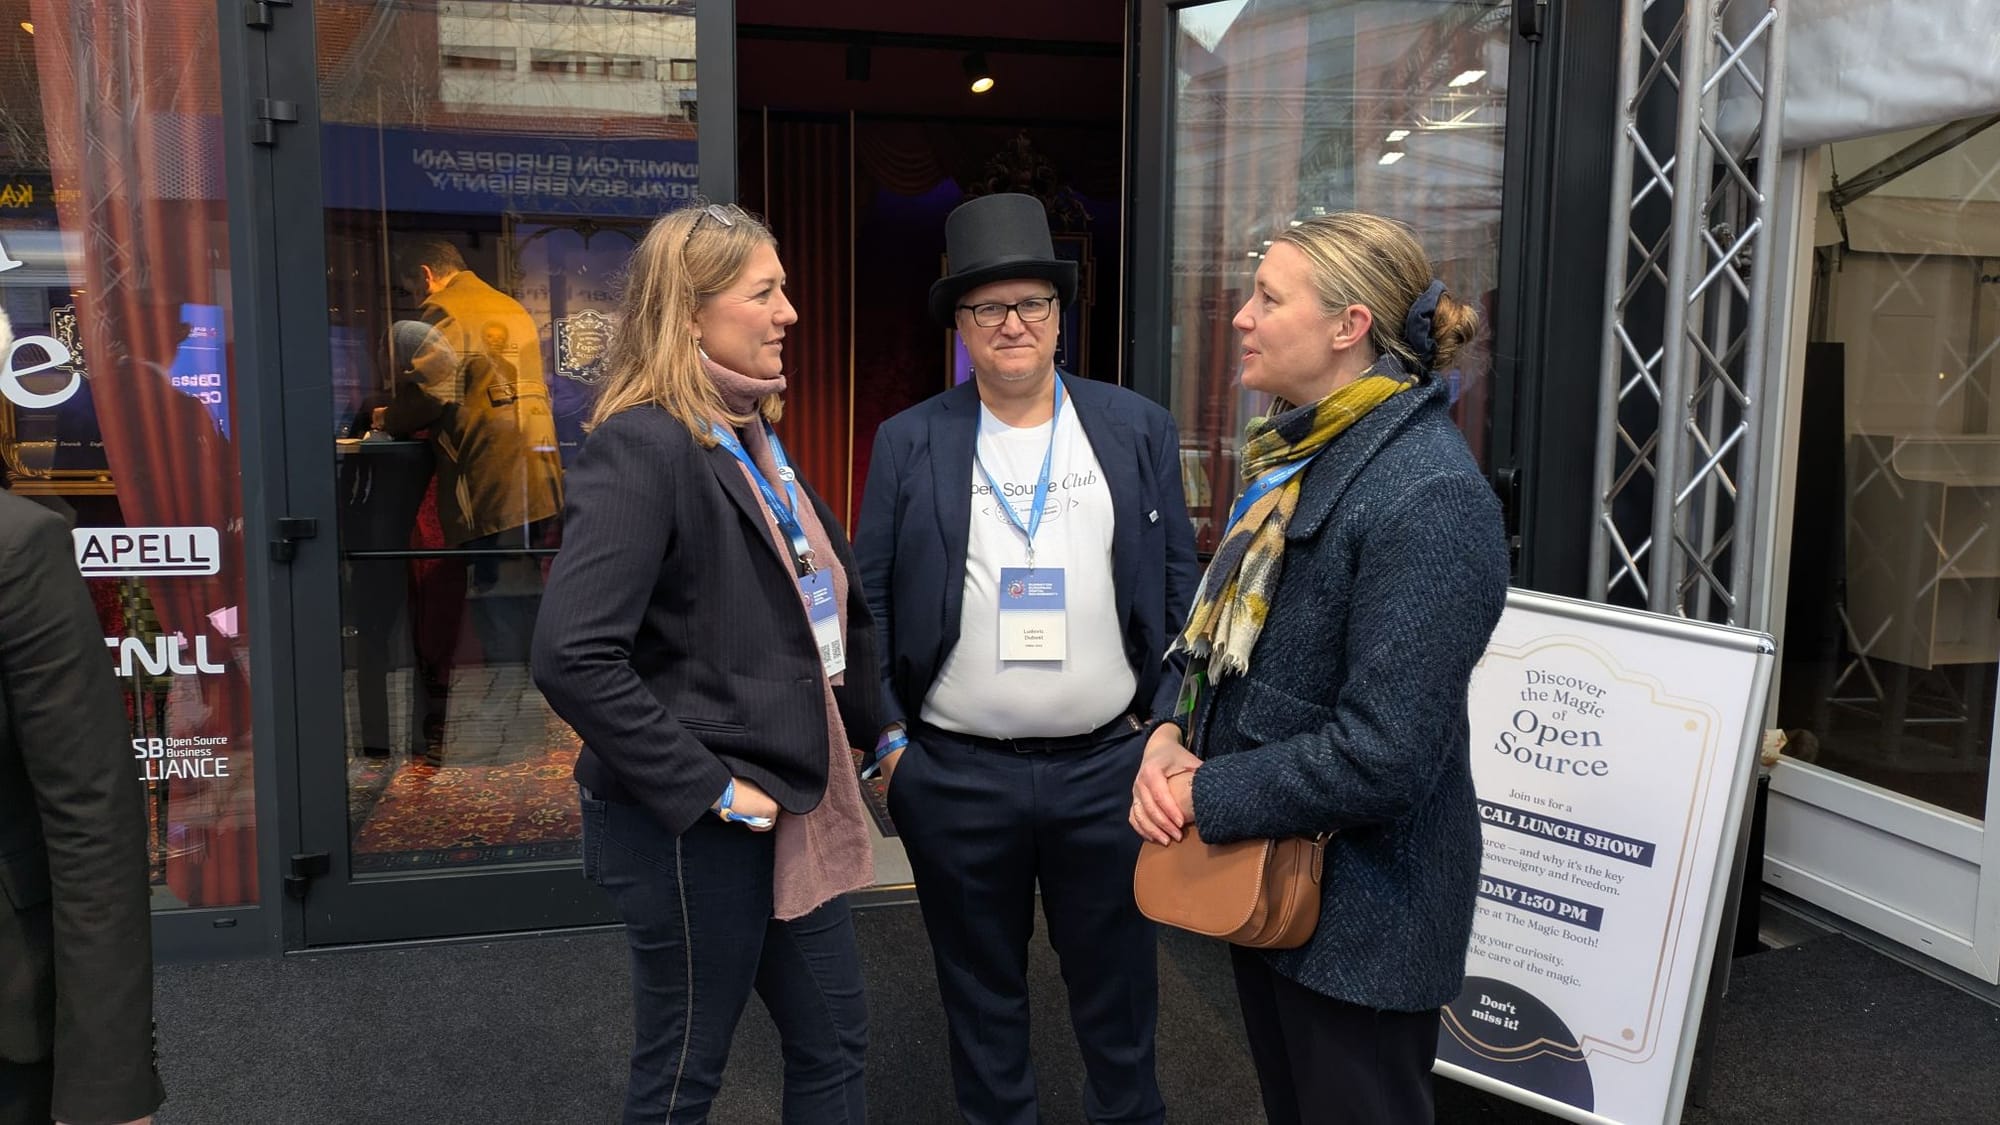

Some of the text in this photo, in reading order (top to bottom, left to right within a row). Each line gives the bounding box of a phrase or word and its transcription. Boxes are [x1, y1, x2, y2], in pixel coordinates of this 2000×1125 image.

[1003, 481, 1057, 497] Soue
[1062, 471, 1097, 490] Club
[81, 534, 210, 564] APELL
[1526, 670, 1606, 699] Discover
[1521, 687, 1605, 718] the Magic
[1552, 711, 1567, 721] of
[1513, 710, 1602, 747] Open
[132, 736, 228, 759] SB Open Source
[166, 748, 212, 758] Business
[1494, 732, 1608, 776] Source
[139, 757, 229, 780] LIANCE
[1509, 788, 1573, 813] Join us for a
[1518, 814, 1580, 843] LUNCH
[1584, 832, 1645, 859] SHOW
[1482, 838, 1506, 850] urce
[1519, 848, 1540, 860] and
[1542, 852, 1565, 868] why
[1584, 863, 1602, 877] the
[1604, 867, 1625, 884] key
[1486, 852, 1620, 897] sovereignty and freedom.
[1478, 879, 1588, 923] DAY 1:30 PM
[1492, 910, 1502, 920] at
[1505, 911, 1525, 927] The
[1527, 919, 1560, 937] Magic
[1562, 929, 1599, 949] Booth!
[1488, 936, 1514, 950] your
[1515, 943, 1564, 967] curiosity.
[1488, 951, 1511, 966] care
[1513, 957, 1523, 969] of
[1526, 962, 1544, 976] the
[1545, 969, 1581, 988] magic.
[1471, 1009, 1520, 1031] miss it!
